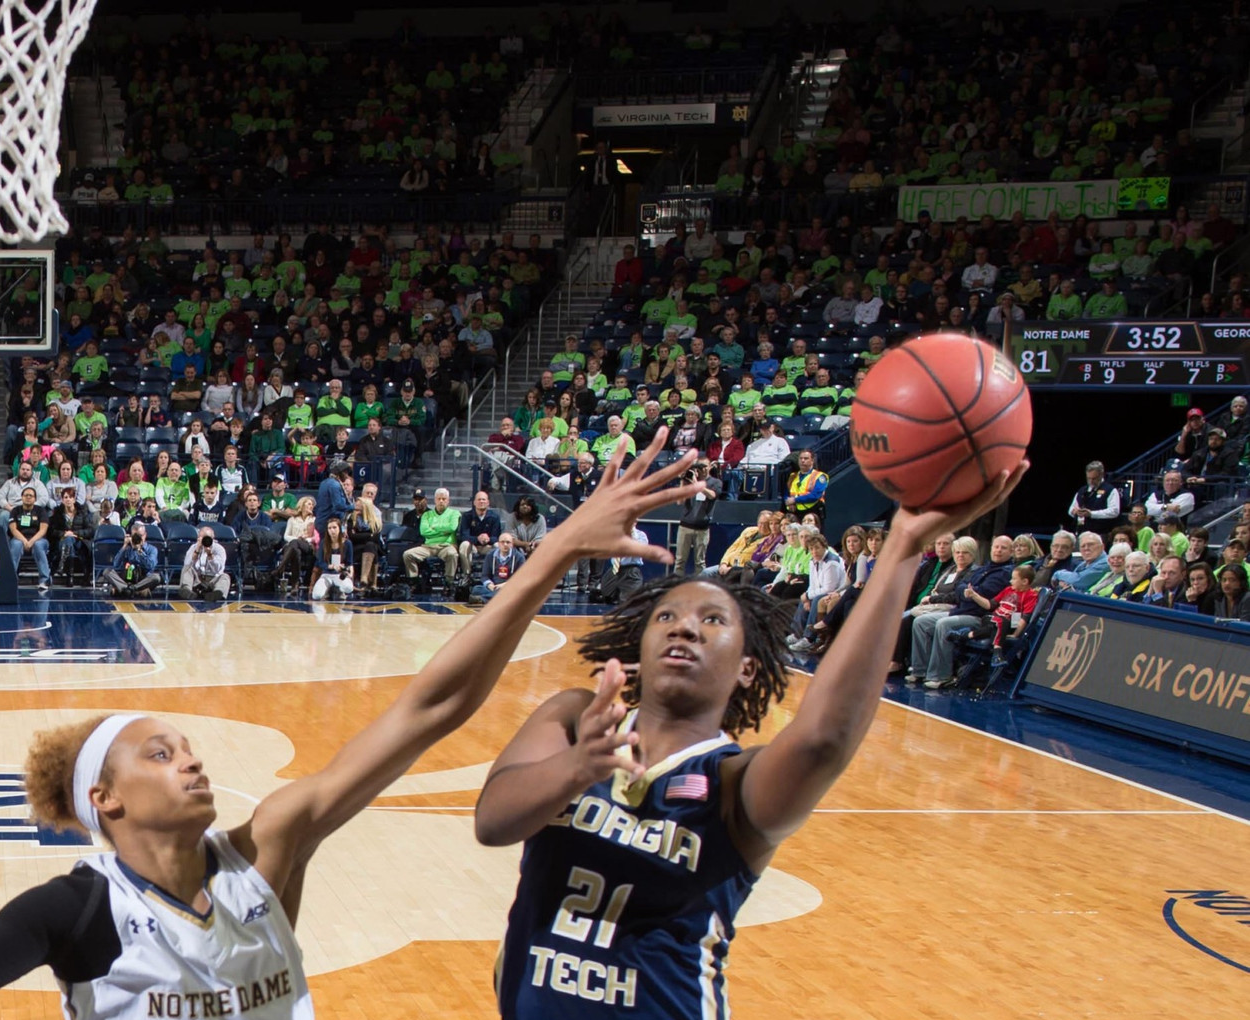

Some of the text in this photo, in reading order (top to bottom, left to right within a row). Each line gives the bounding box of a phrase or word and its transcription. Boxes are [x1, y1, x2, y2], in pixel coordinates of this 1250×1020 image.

[617, 112, 709, 122] VIRGINIA TECH
[1023, 330, 1091, 340] NOTRE DAME
[1127, 327, 1181, 349] 3:52
[1020, 350, 1051, 373] 81
[1143, 361, 1165, 369] HALF
[1103, 368, 1115, 384] 9
[1145, 368, 1156, 384] 2
[1188, 368, 1200, 384] 7
[359, 467, 366, 476] 6
[752, 476, 759, 486] 7
[1125, 653, 1173, 693] SIX
[548, 793, 701, 873] EORGIA
[551, 866, 634, 948] 21
[530, 946, 637, 1007] TECH
[147, 970, 292, 1018] NOTRE DAME
